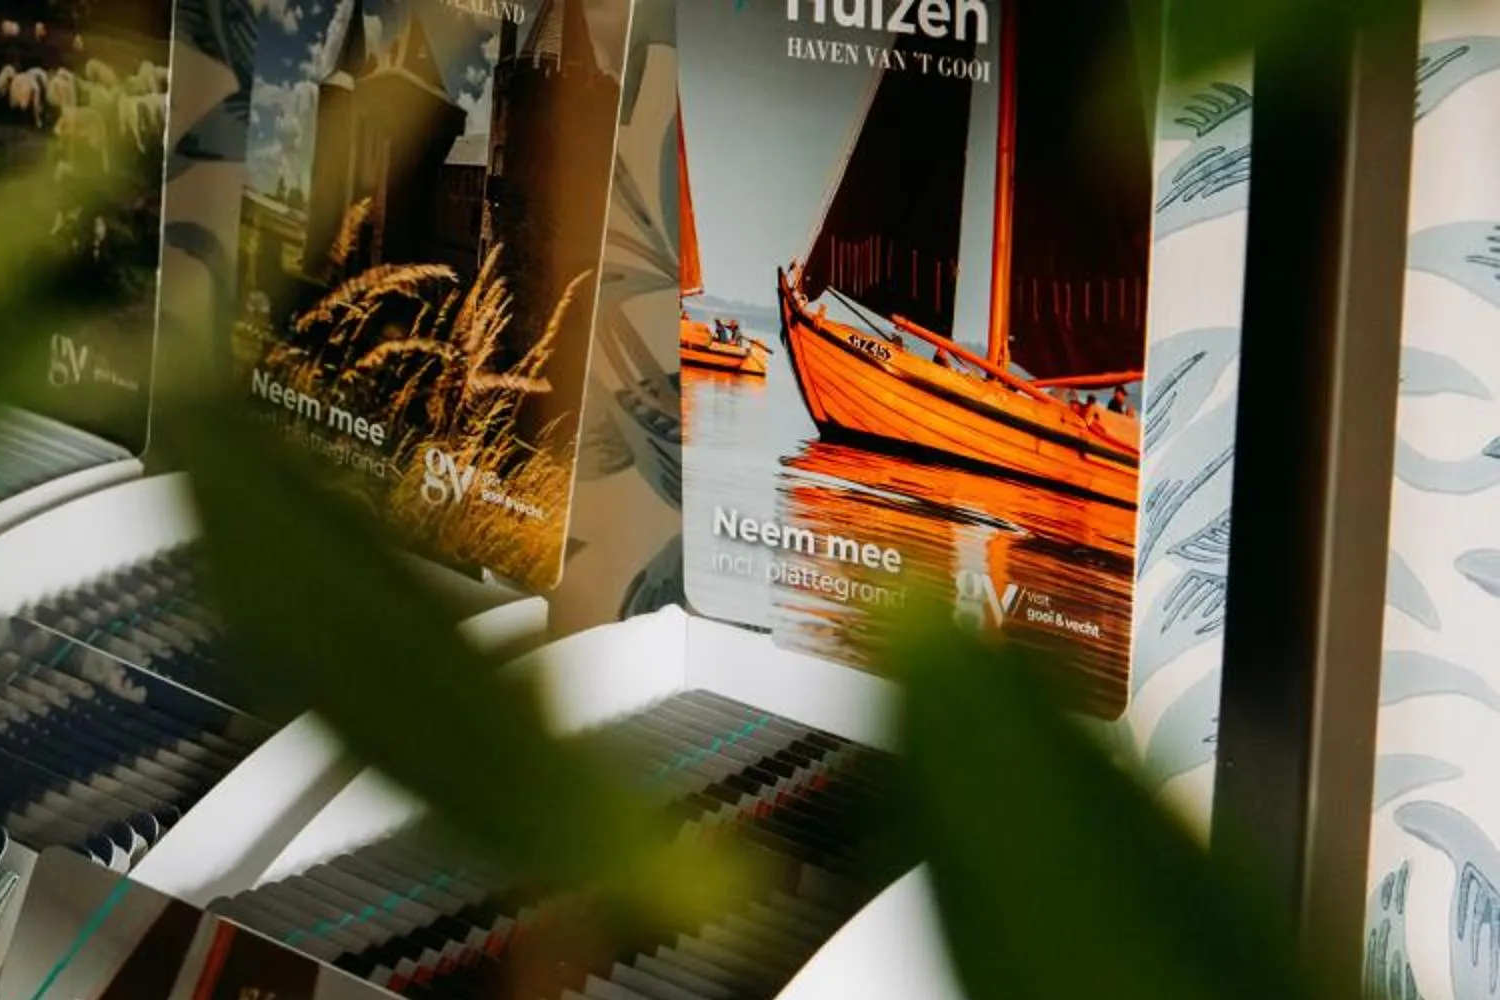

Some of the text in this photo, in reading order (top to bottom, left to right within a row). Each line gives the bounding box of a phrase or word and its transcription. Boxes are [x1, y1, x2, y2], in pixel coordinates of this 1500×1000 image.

[786, 37, 860, 66] HAVEN
[864, 45, 908, 72] VAN
[937, 55, 992, 84] GOOI
[251, 367, 387, 446] Neem mee
[712, 505, 902, 574] Neem mee
[1026, 606, 1055, 624] gooi
